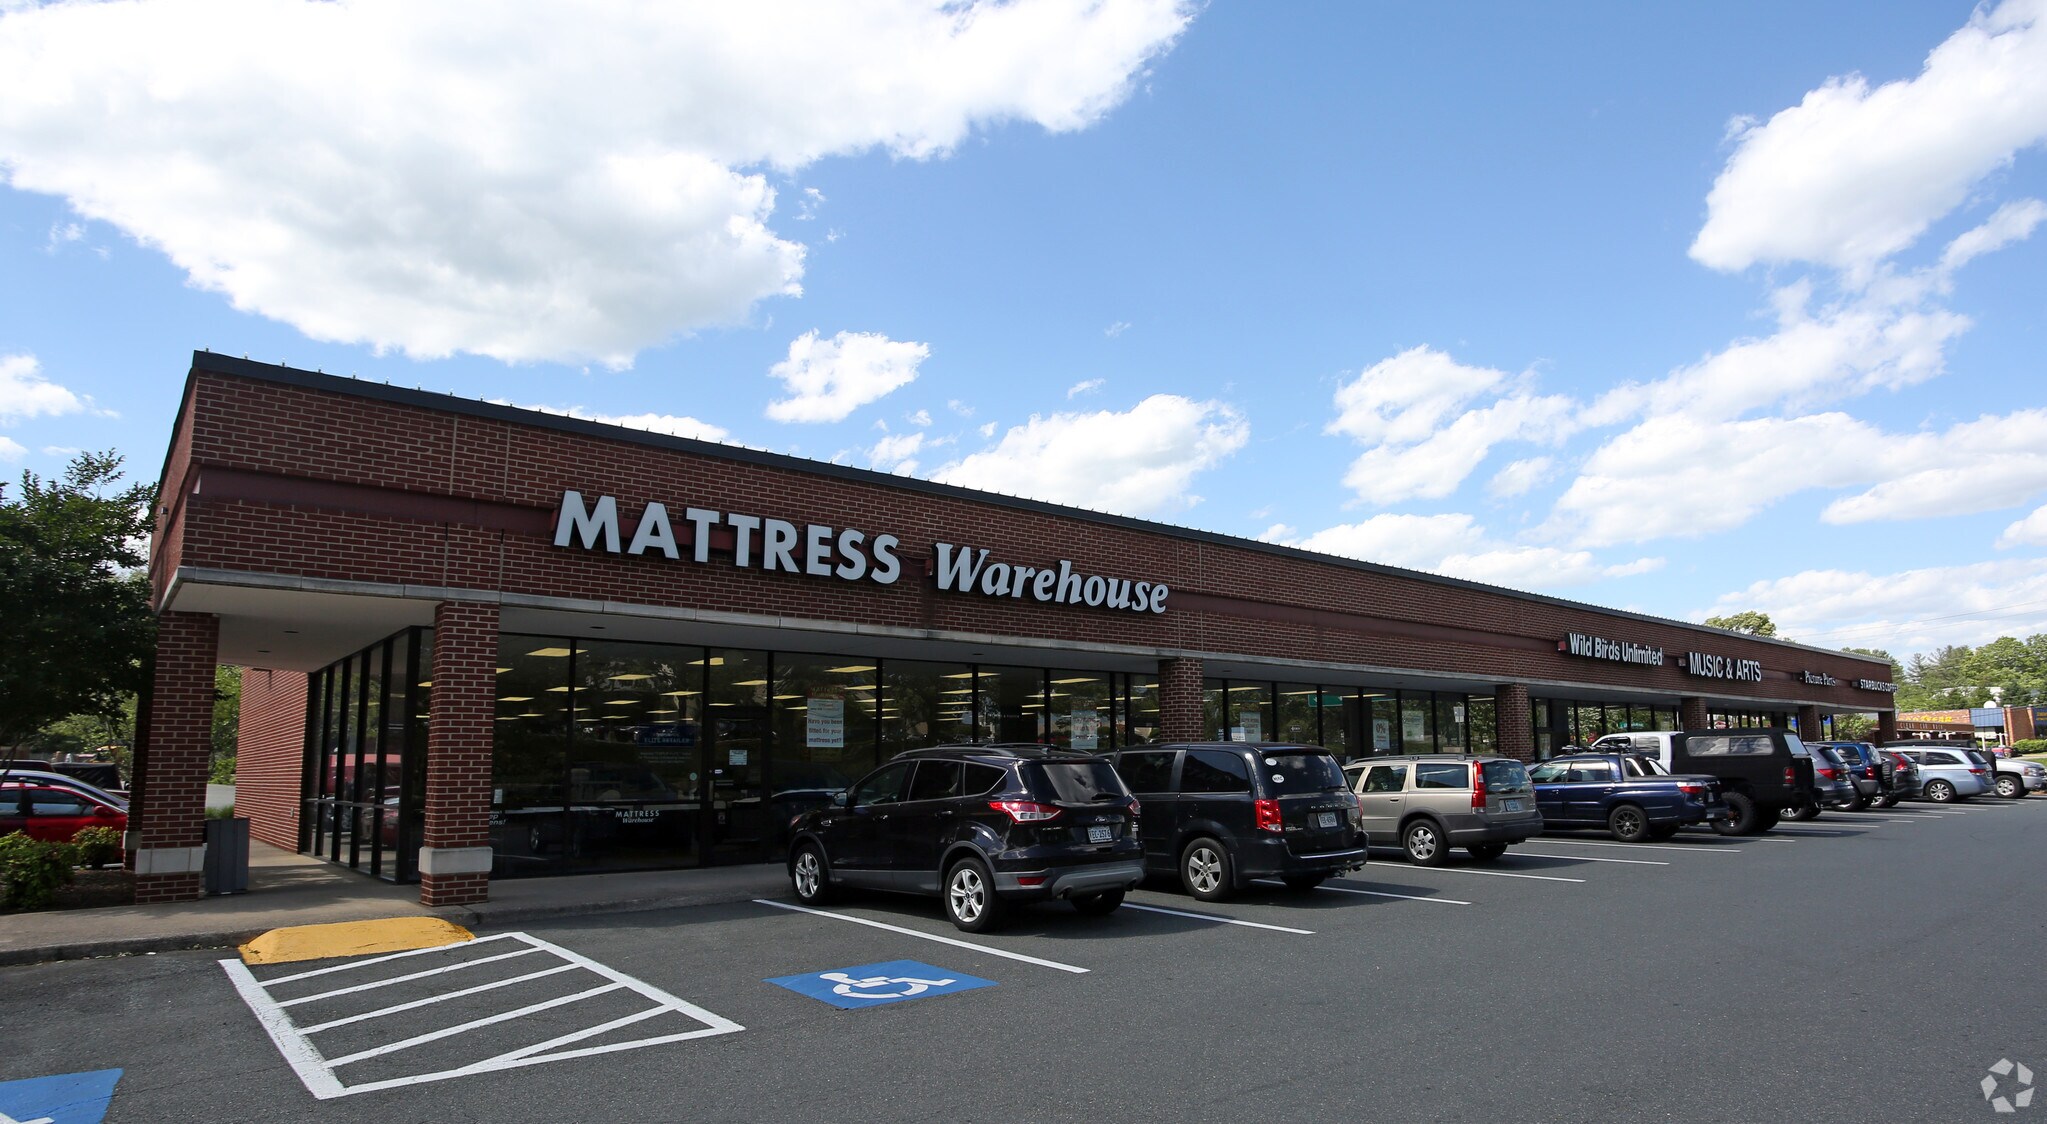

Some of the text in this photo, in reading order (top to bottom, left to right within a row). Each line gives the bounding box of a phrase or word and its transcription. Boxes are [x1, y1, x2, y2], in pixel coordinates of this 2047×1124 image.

[553, 490, 1169, 614] MATTRESS Warehouse
[1569, 633, 1663, 665] Wild Birds Unlimited
[1689, 651, 1761, 681] MUSIC & ARTS
[1860, 679, 1885, 691] STARBUCKS
[615, 809, 660, 818] MATTRESS
